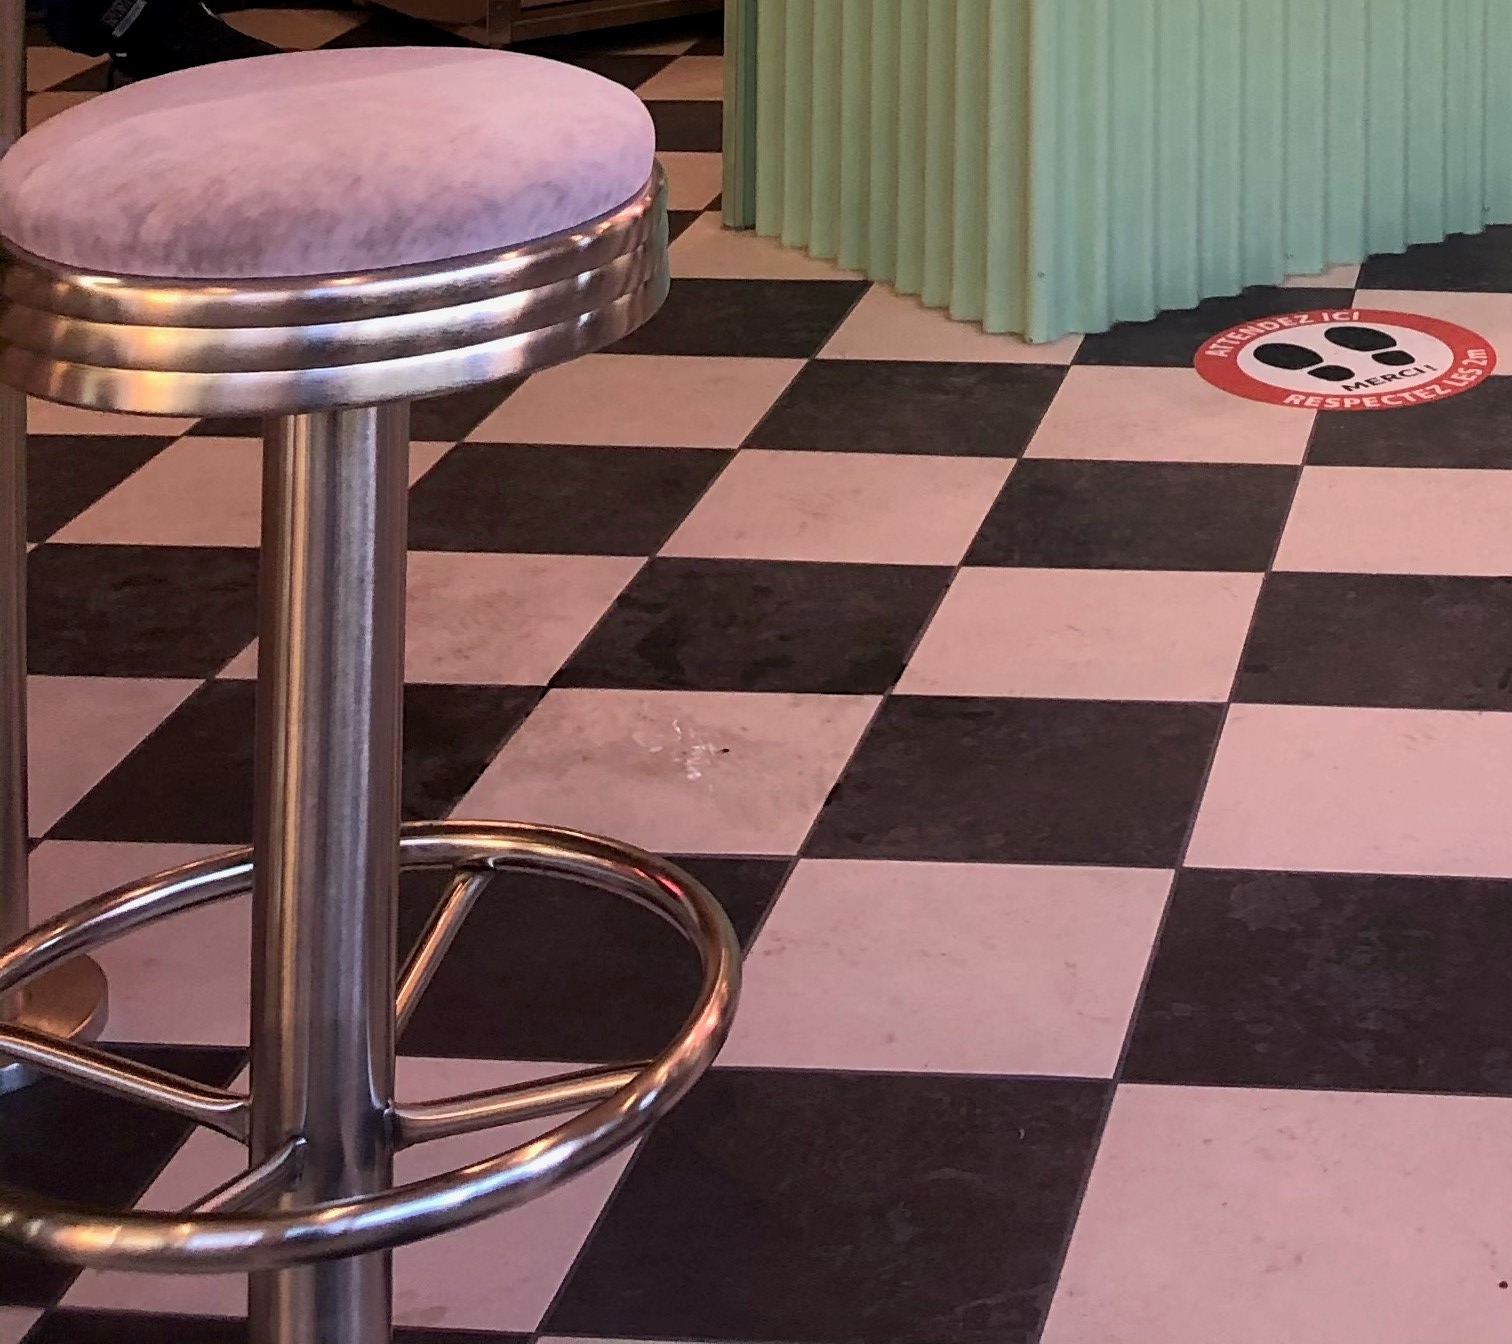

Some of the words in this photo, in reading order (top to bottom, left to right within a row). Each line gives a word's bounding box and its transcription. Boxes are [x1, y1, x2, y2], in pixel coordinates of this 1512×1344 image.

[1204, 312, 1315, 359] ATTENDEZ
[1321, 311, 1361, 322] ICI
[1283, 383, 1452, 409] RESPECTEZ
[1449, 358, 1483, 388] LES
[1341, 367, 1421, 392] MERCI
